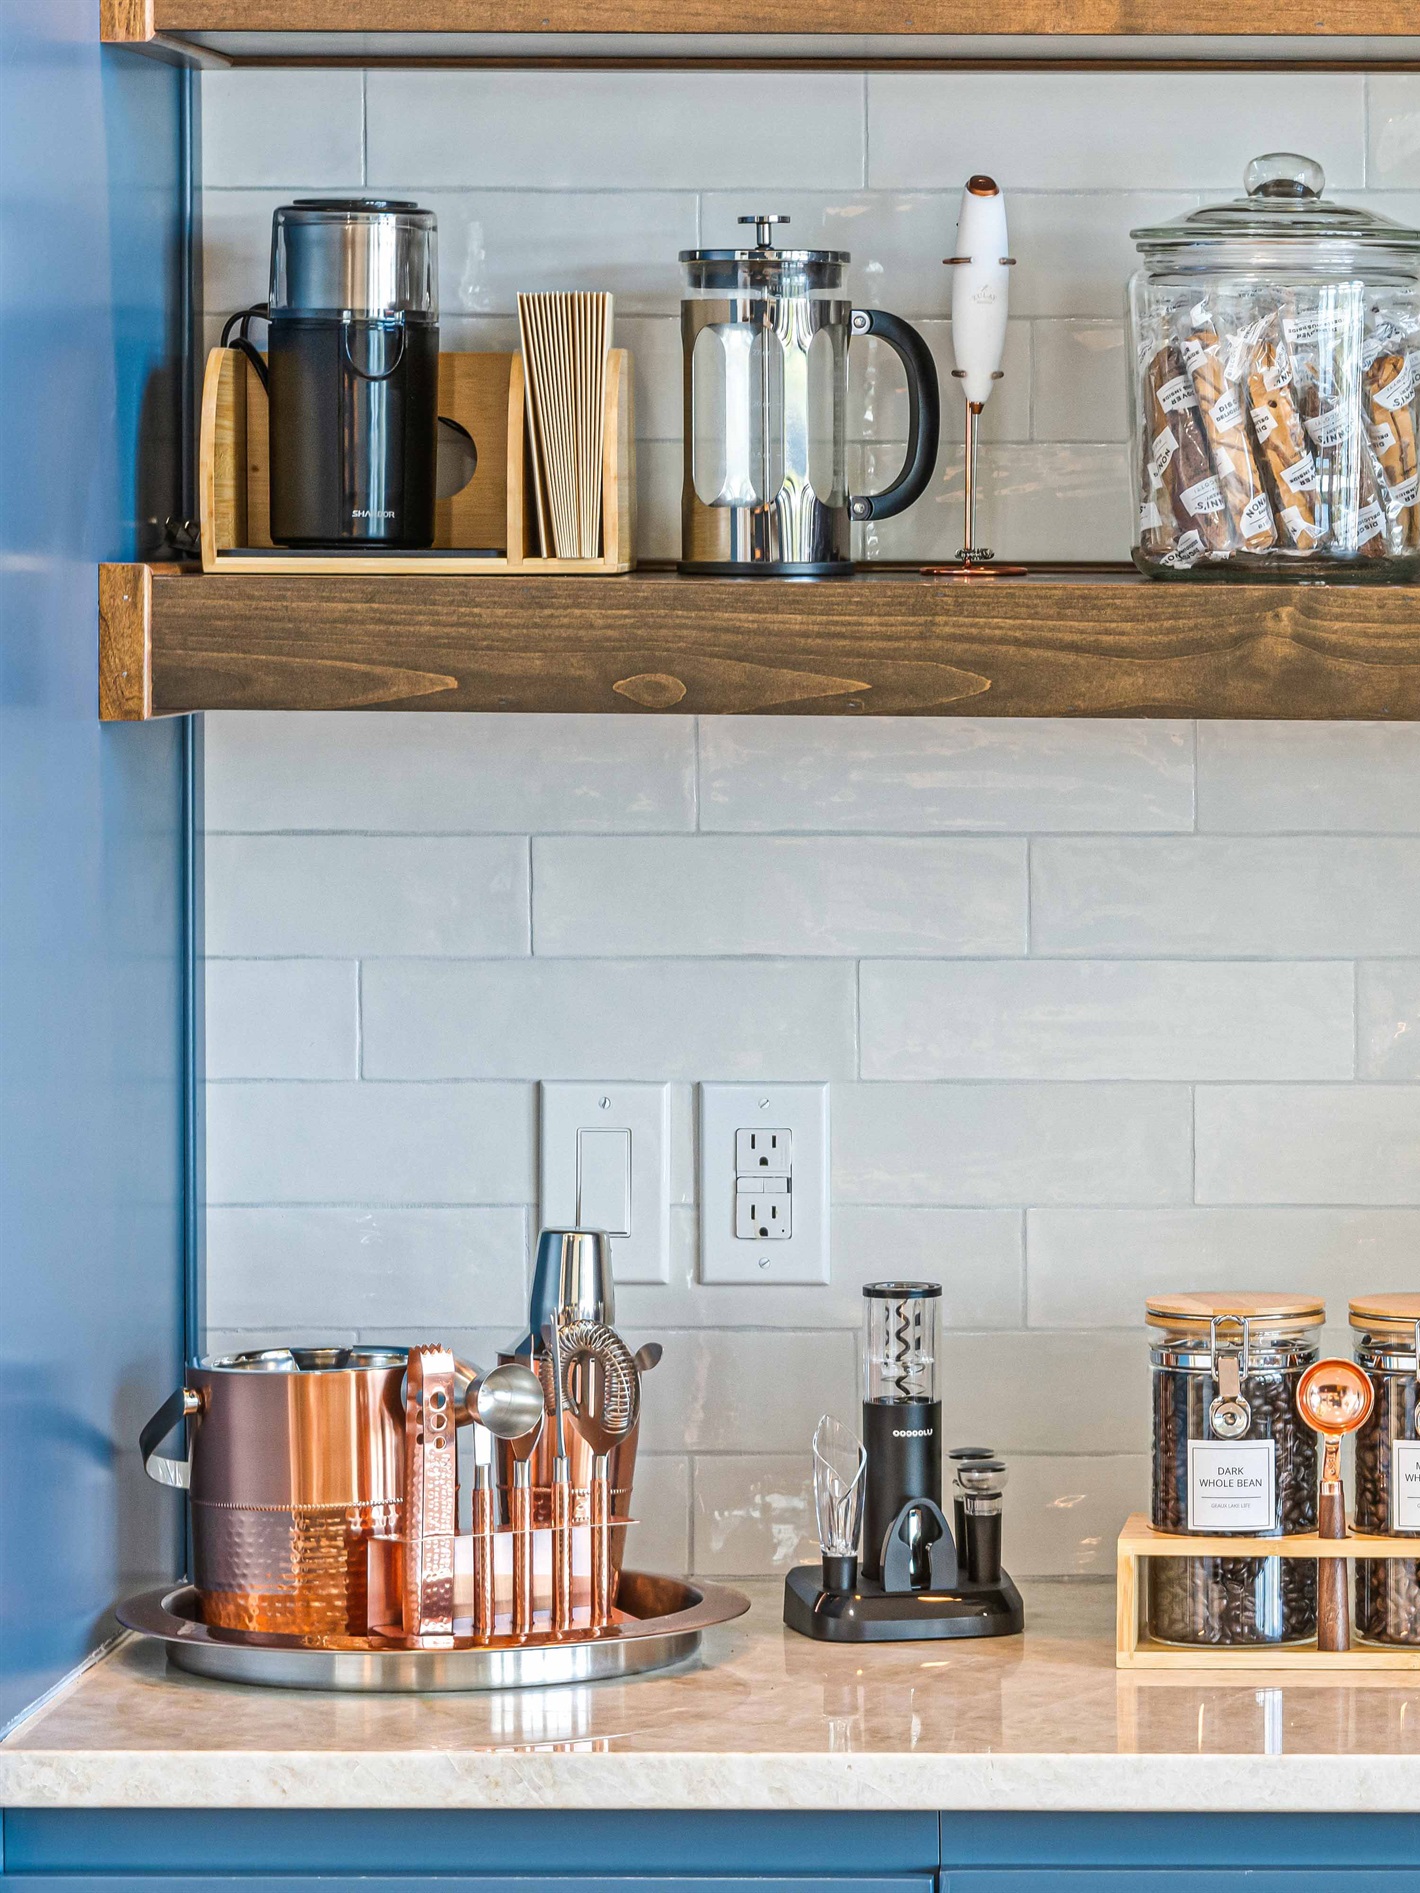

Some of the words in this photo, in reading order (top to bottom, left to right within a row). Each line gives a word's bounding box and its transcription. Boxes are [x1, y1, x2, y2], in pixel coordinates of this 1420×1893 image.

[351, 509, 395, 518] SHADOR
[1217, 1467, 1244, 1476] DARK
[1199, 1479, 1234, 1488] WHOLE
[1236, 1479, 1263, 1488] BEAN
